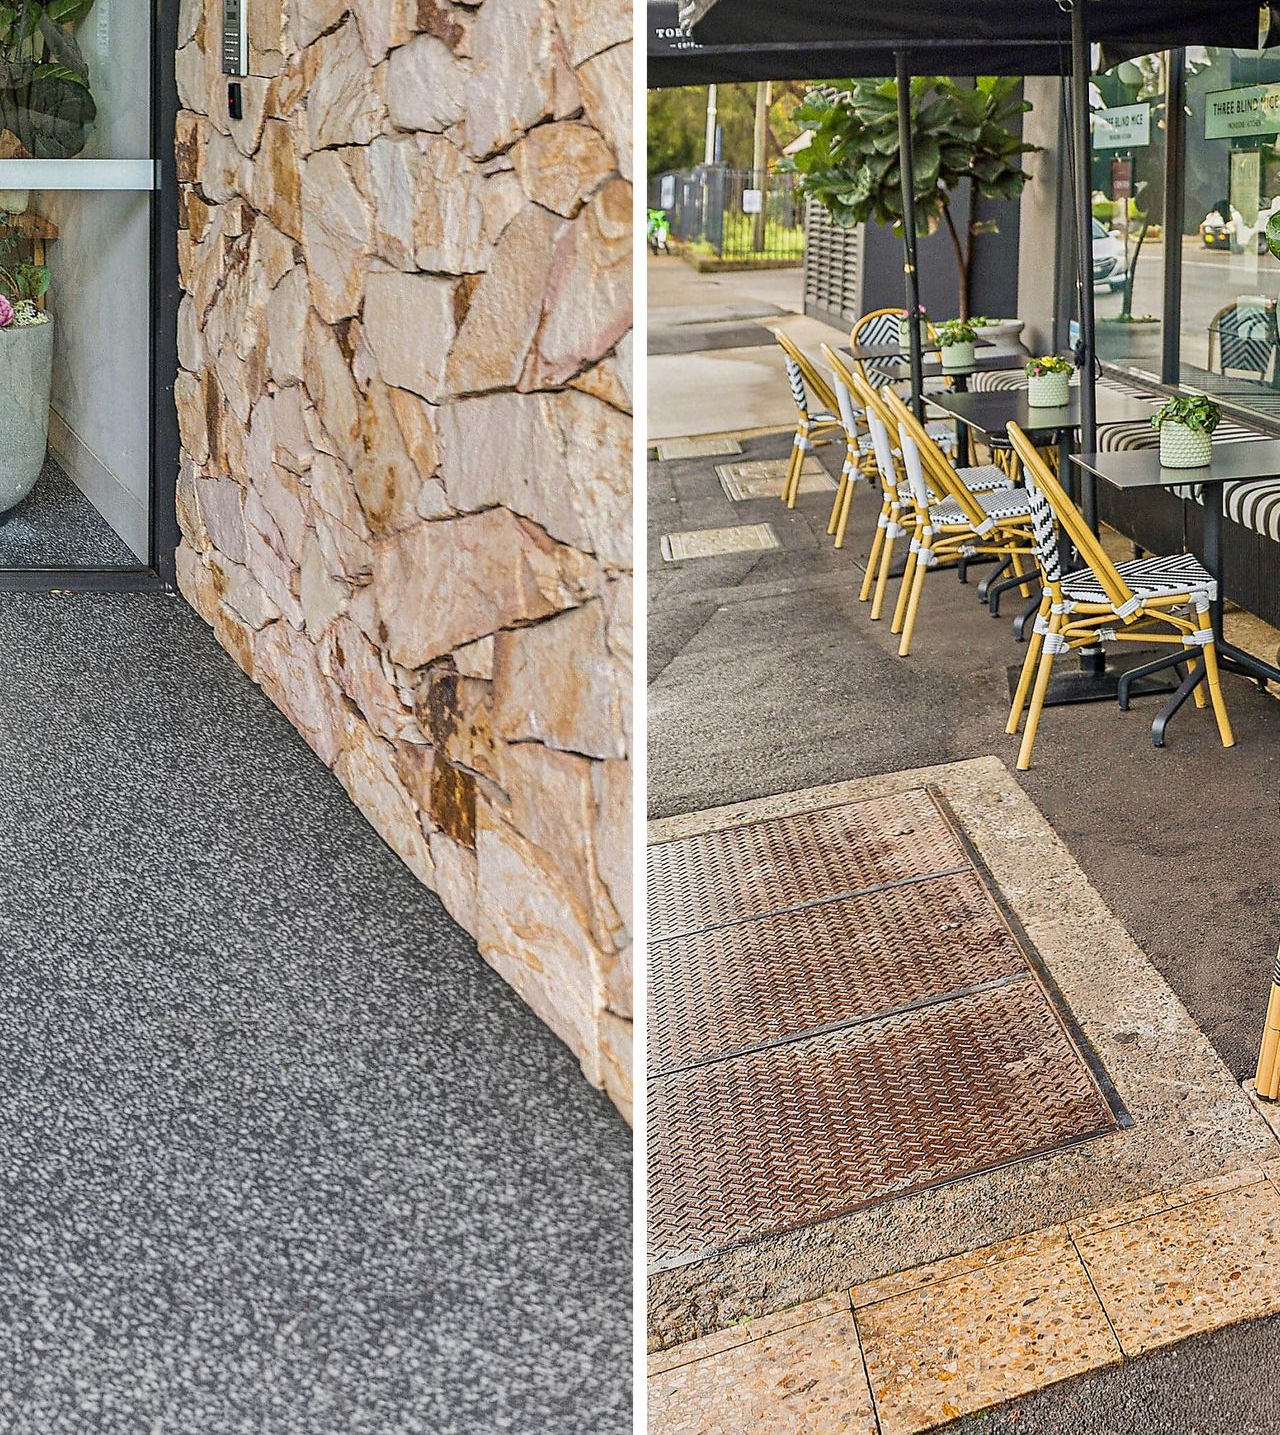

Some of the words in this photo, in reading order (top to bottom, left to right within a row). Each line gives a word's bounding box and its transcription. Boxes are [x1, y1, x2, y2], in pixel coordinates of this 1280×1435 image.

[1213, 100, 1235, 116] THREE
[1236, 97, 1257, 113] BLIND
[1259, 94, 1279, 109] MICE
[1114, 116, 1130, 128] BLIND
[1131, 113, 1143, 126] MICE
